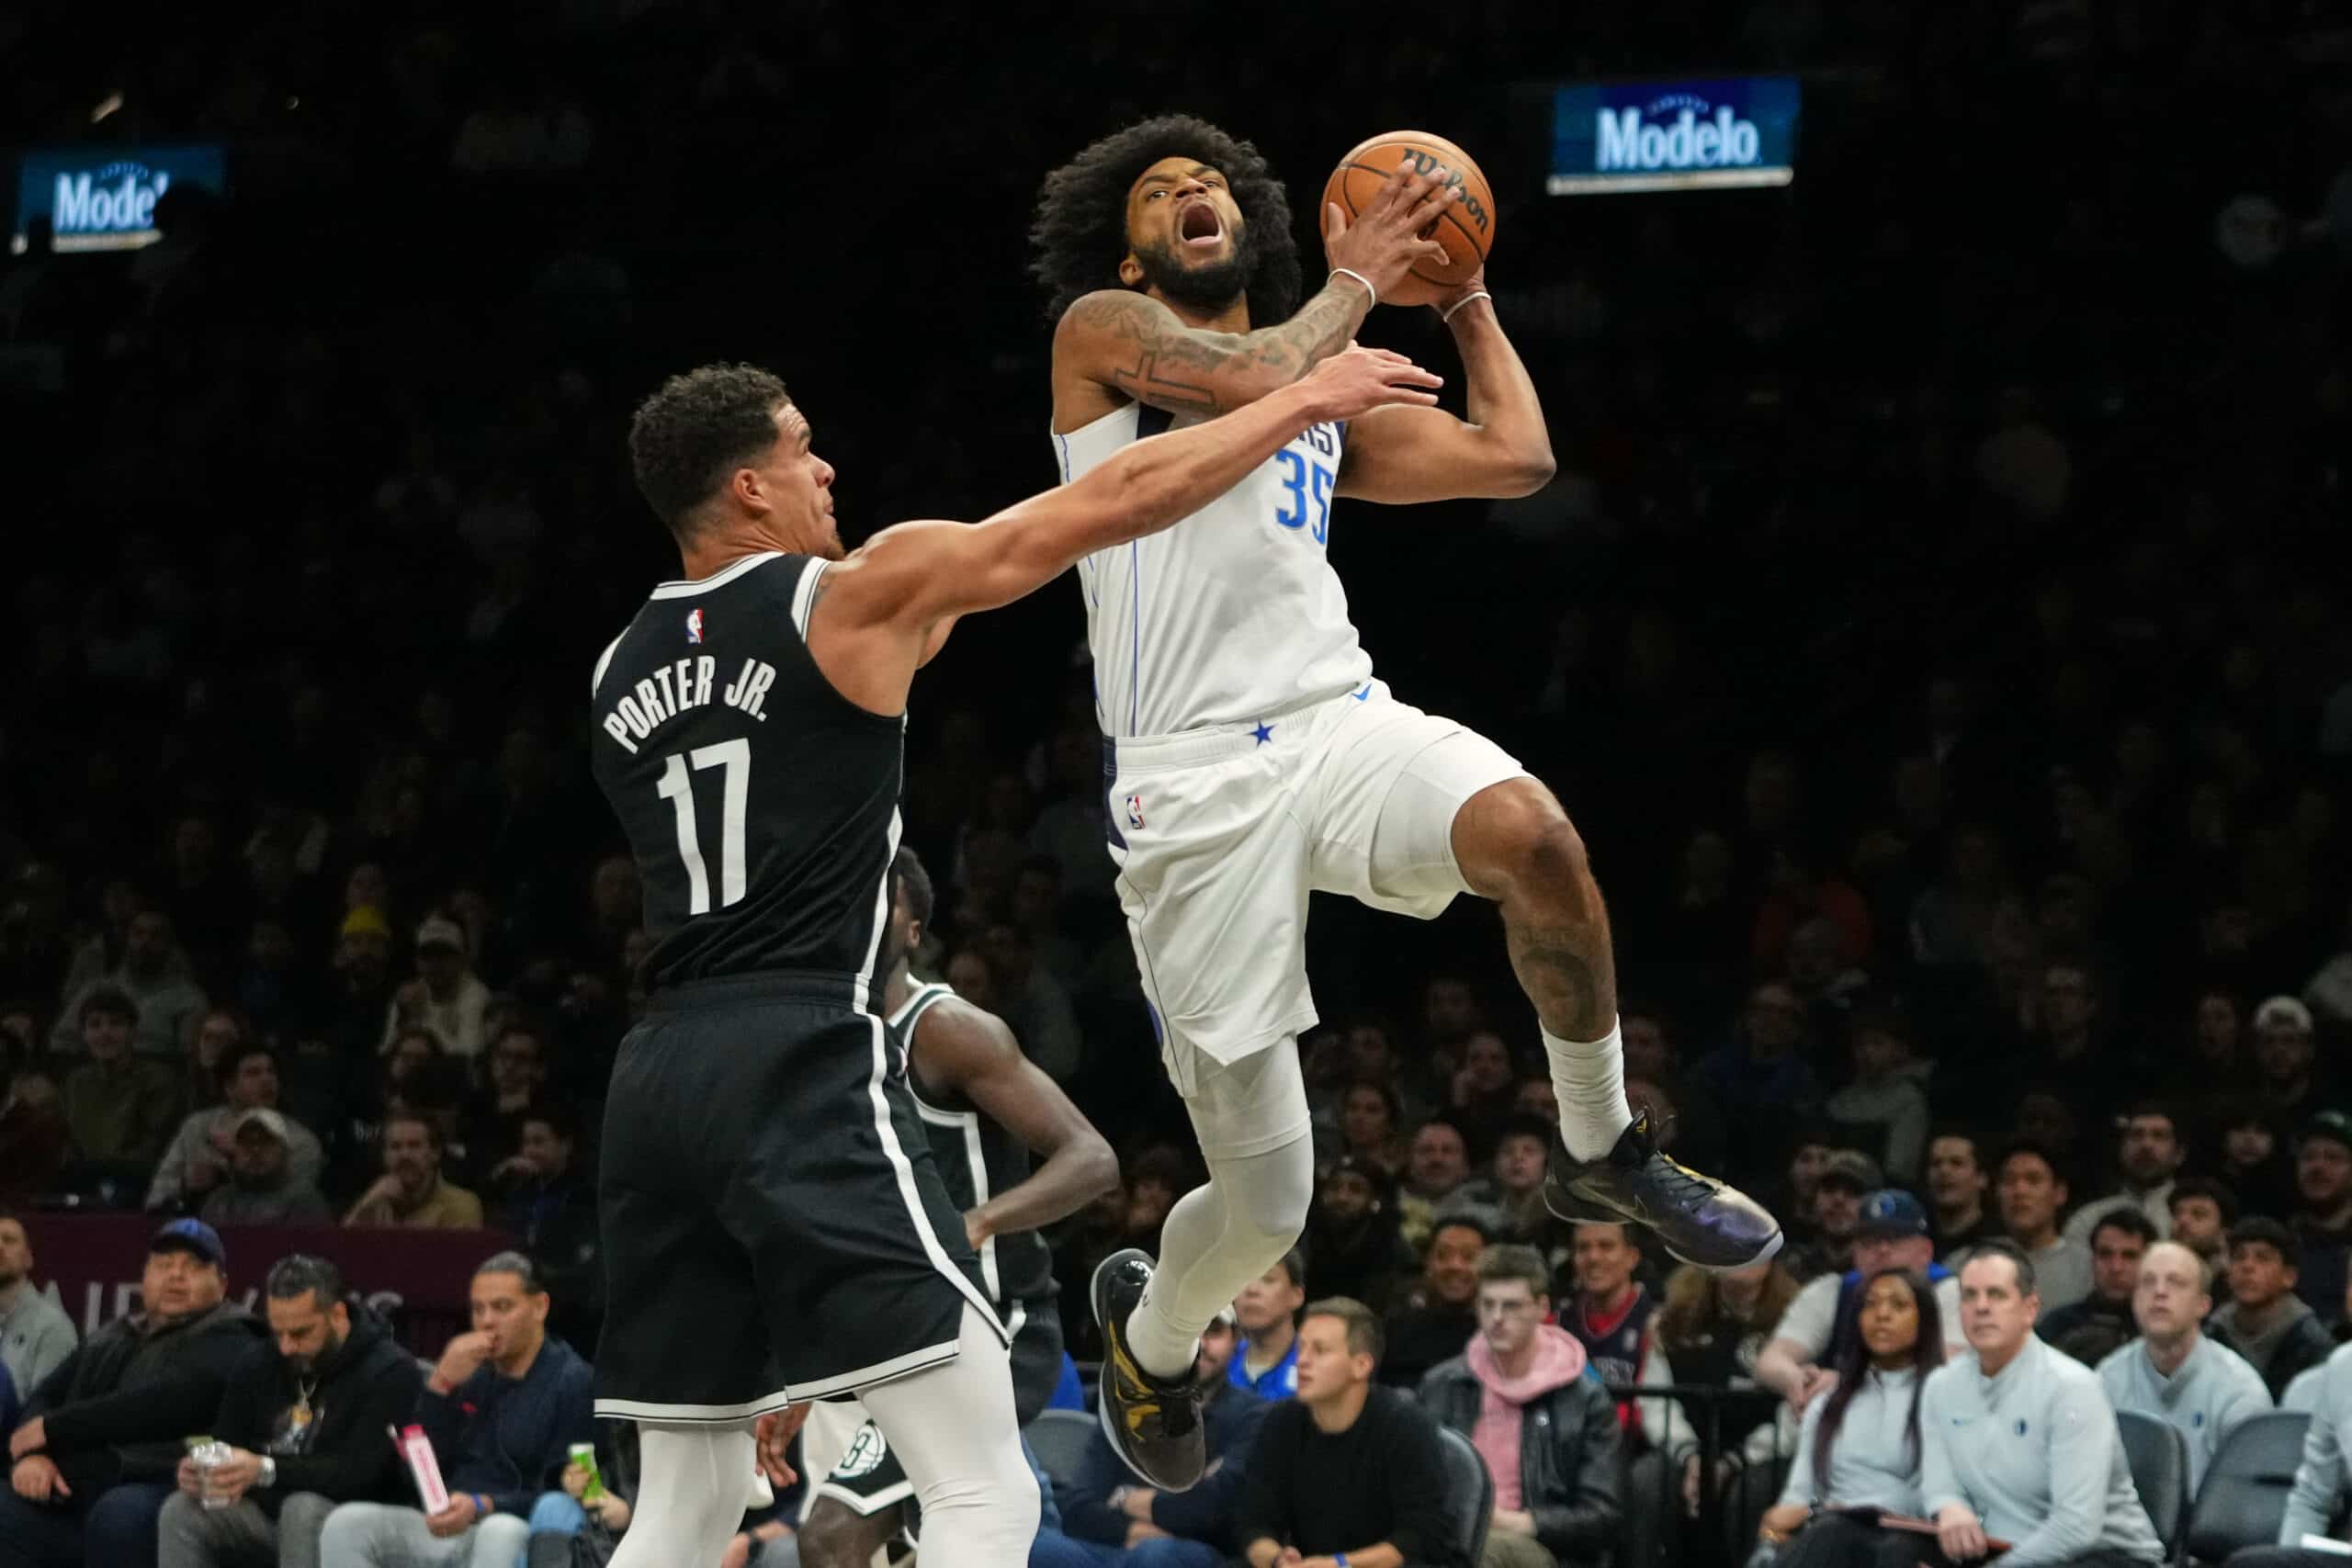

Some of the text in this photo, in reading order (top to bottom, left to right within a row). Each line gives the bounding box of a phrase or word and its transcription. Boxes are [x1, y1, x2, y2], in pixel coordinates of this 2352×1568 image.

[1596, 106, 1759, 170] Modelo
[1403, 148, 1487, 235] Wlson
[1275, 447, 1334, 545] 35
[603, 655, 777, 755] PORTER JR.
[656, 738, 752, 916] 17
